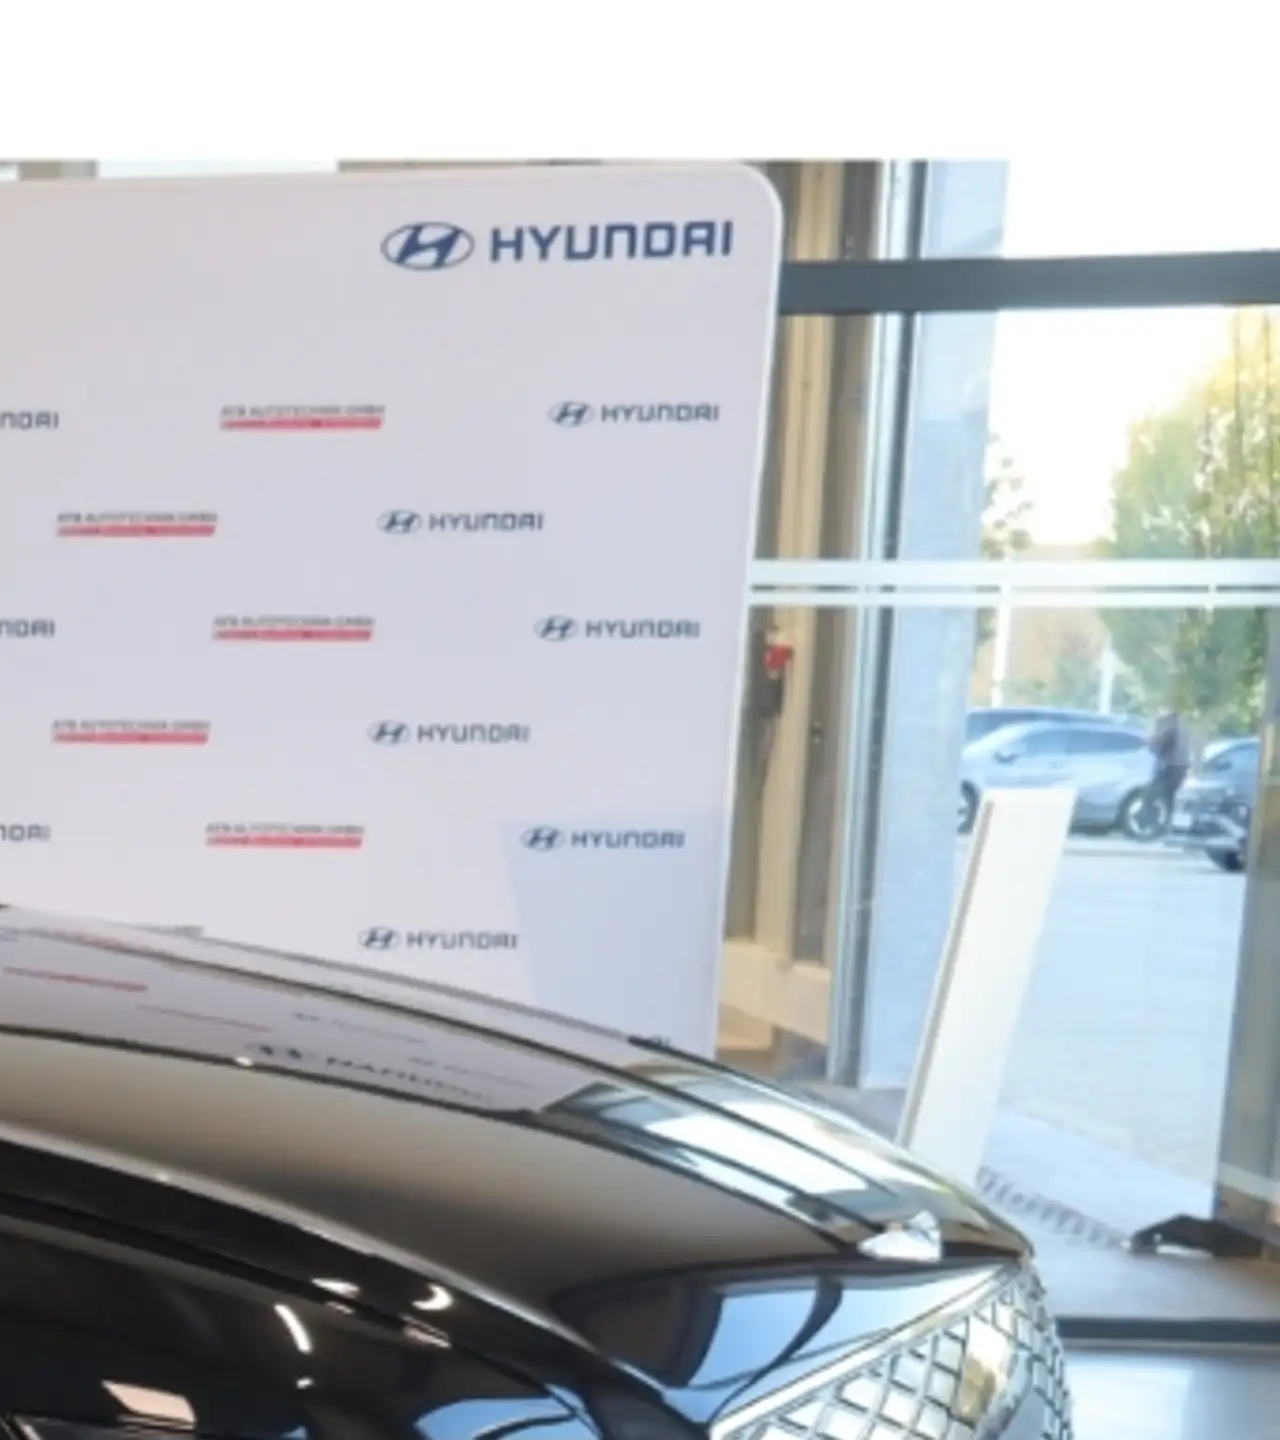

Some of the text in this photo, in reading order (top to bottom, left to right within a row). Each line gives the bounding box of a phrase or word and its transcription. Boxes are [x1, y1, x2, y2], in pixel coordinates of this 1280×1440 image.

[490, 220, 735, 263] HYUNDAI
[600, 403, 720, 423] HYUNDAI
[428, 512, 544, 532] HYUNDAI
[585, 619, 701, 639] HYUNDAI
[416, 723, 530, 744] HYUNDAI
[570, 830, 686, 850] HYUNDAI
[406, 931, 519, 951] HYUNDAI
